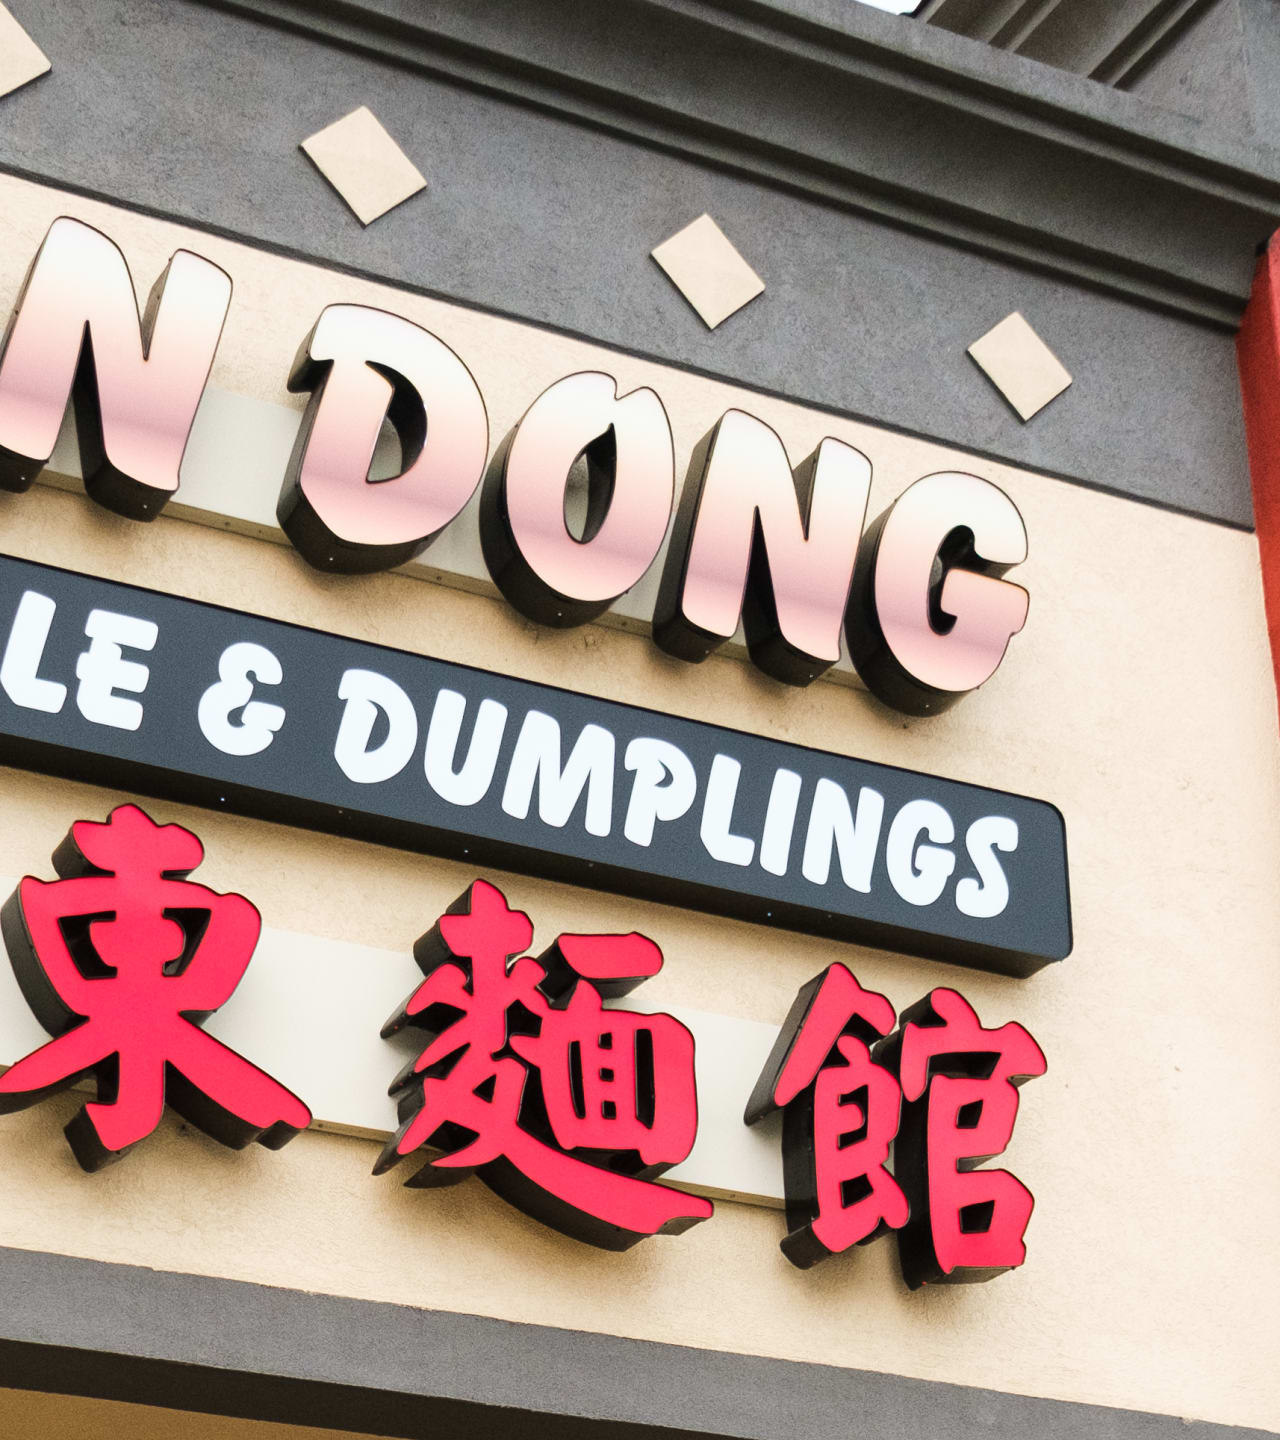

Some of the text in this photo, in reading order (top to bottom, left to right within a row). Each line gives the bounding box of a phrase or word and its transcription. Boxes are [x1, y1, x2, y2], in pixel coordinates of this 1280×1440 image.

[283, 302, 1032, 700] DONG
[198, 640, 286, 759] &
[336, 666, 1021, 920] DUMPLINGS
